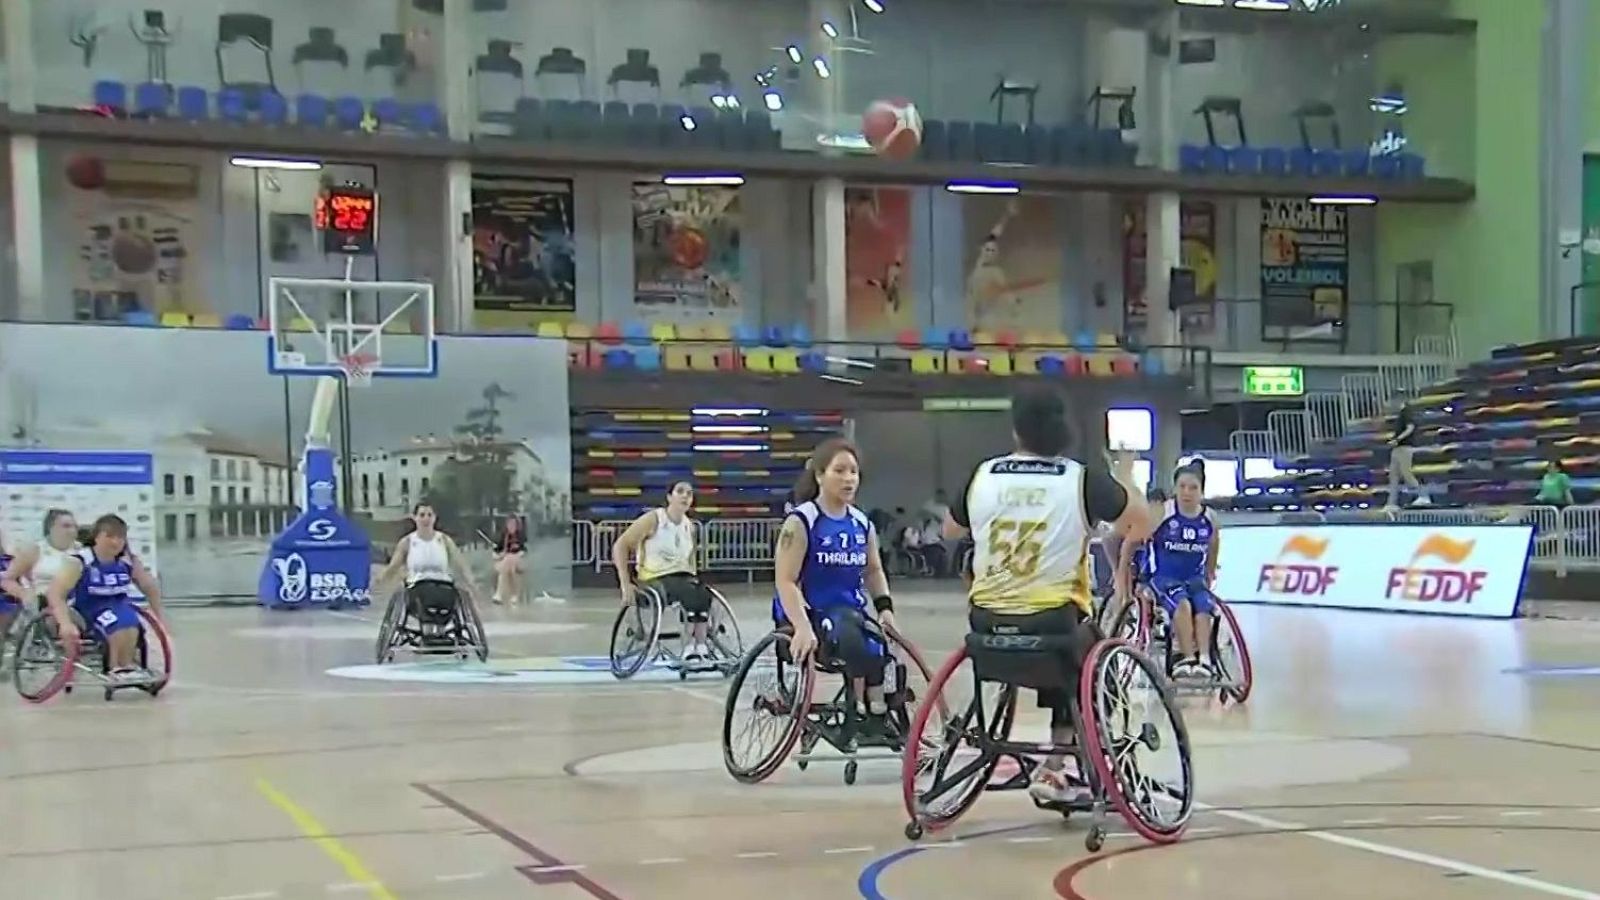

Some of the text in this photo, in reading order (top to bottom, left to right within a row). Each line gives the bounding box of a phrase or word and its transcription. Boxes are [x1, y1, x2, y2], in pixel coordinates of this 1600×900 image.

[839, 533, 848, 548] 7
[1182, 527, 1196, 540] 10
[310, 573, 347, 587] BSR
[1256, 564, 1340, 596] FEDDF
[1384, 567, 1488, 603] FEDDF
